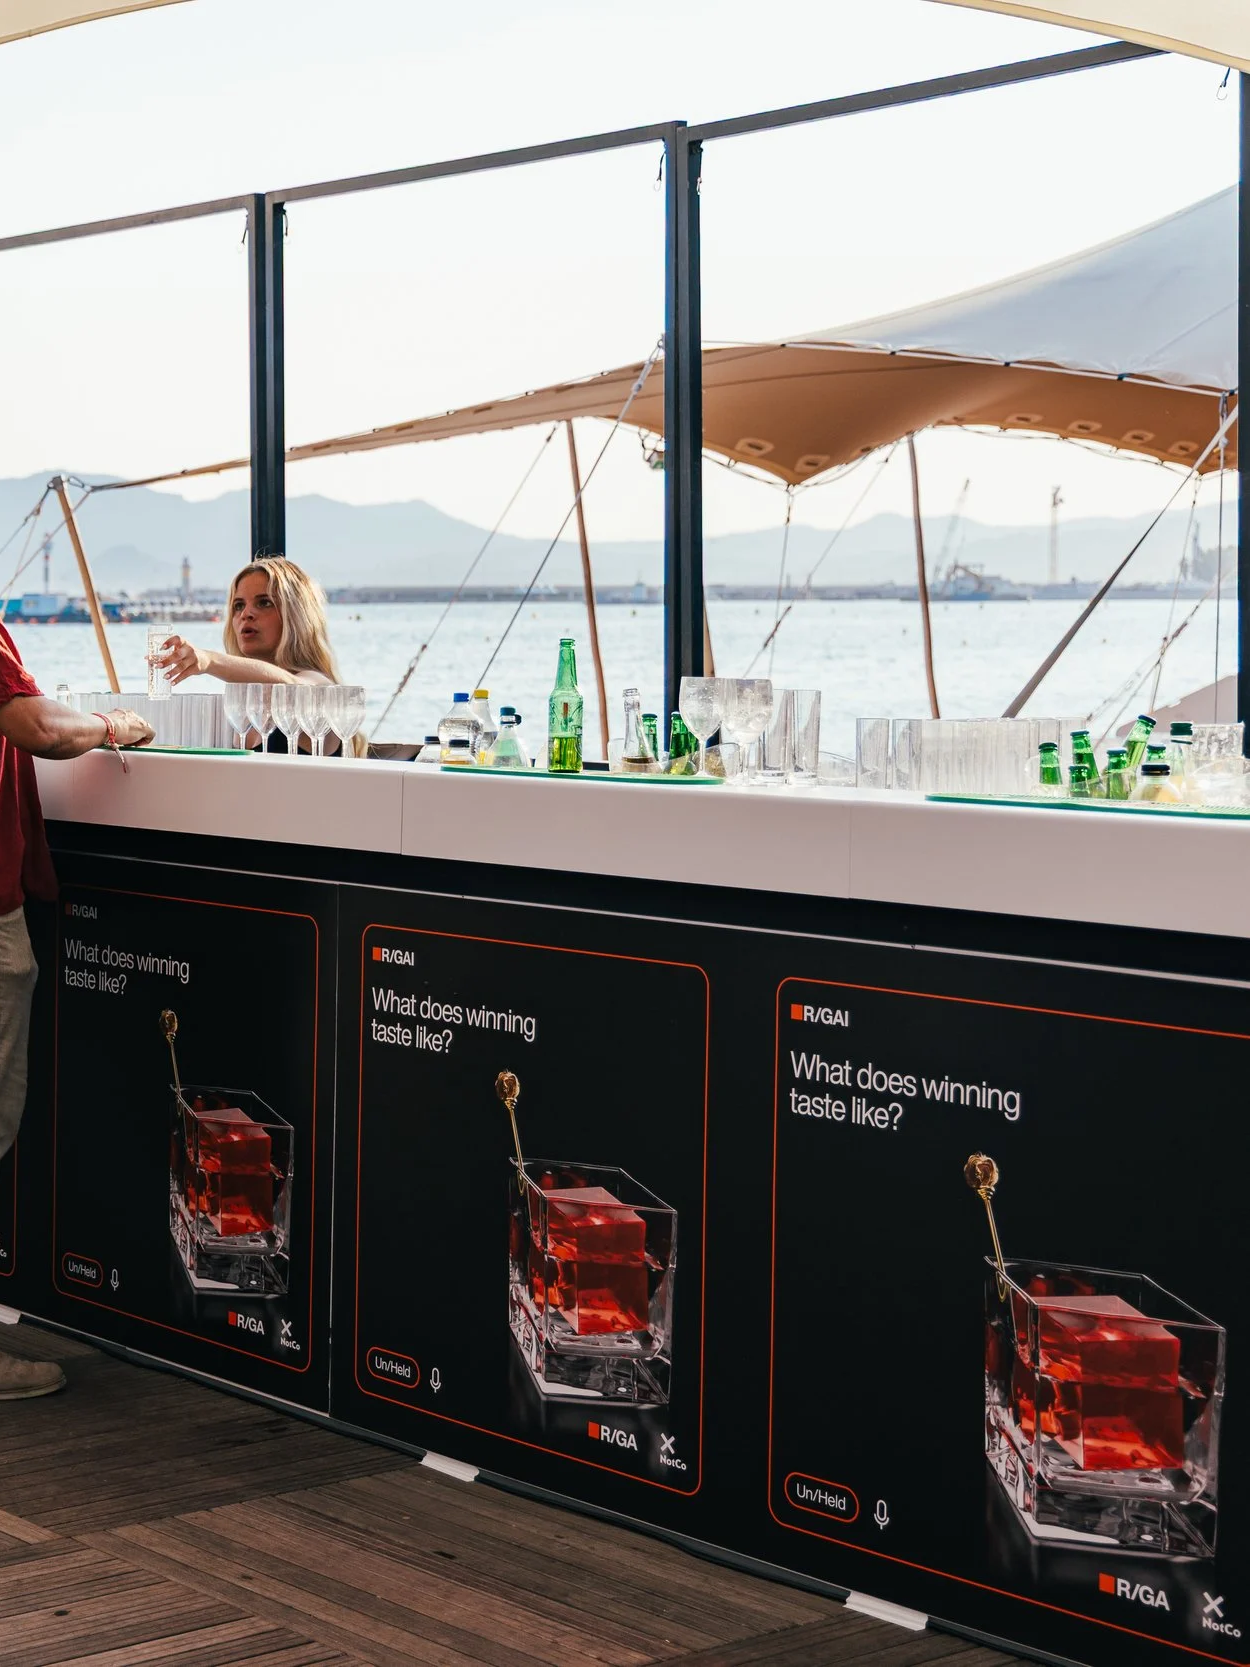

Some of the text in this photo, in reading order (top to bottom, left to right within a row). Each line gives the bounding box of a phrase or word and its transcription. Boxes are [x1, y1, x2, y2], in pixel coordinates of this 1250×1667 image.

[72, 904, 98, 920] R/GAI
[64, 937, 190, 985] What does winning
[381, 948, 415, 967] R/GAI
[64, 965, 127, 995] taste like?
[371, 986, 537, 1043] What does winning
[803, 1004, 849, 1028] R/GAI
[370, 1018, 454, 1054] taste like?
[789, 1050, 1021, 1122] What does winning
[789, 1087, 904, 1132] taste like?
[67, 1260, 97, 1280] Un/Held
[237, 1313, 265, 1336] R/GA
[280, 1335, 301, 1352] NotCo
[374, 1355, 411, 1380] Un/Held
[600, 1424, 639, 1452] R/GA
[659, 1452, 687, 1472] NotCo
[796, 1482, 847, 1512] Un/Held
[1116, 1577, 1171, 1612] R/GA
[1201, 1615, 1242, 1639] NotCo
